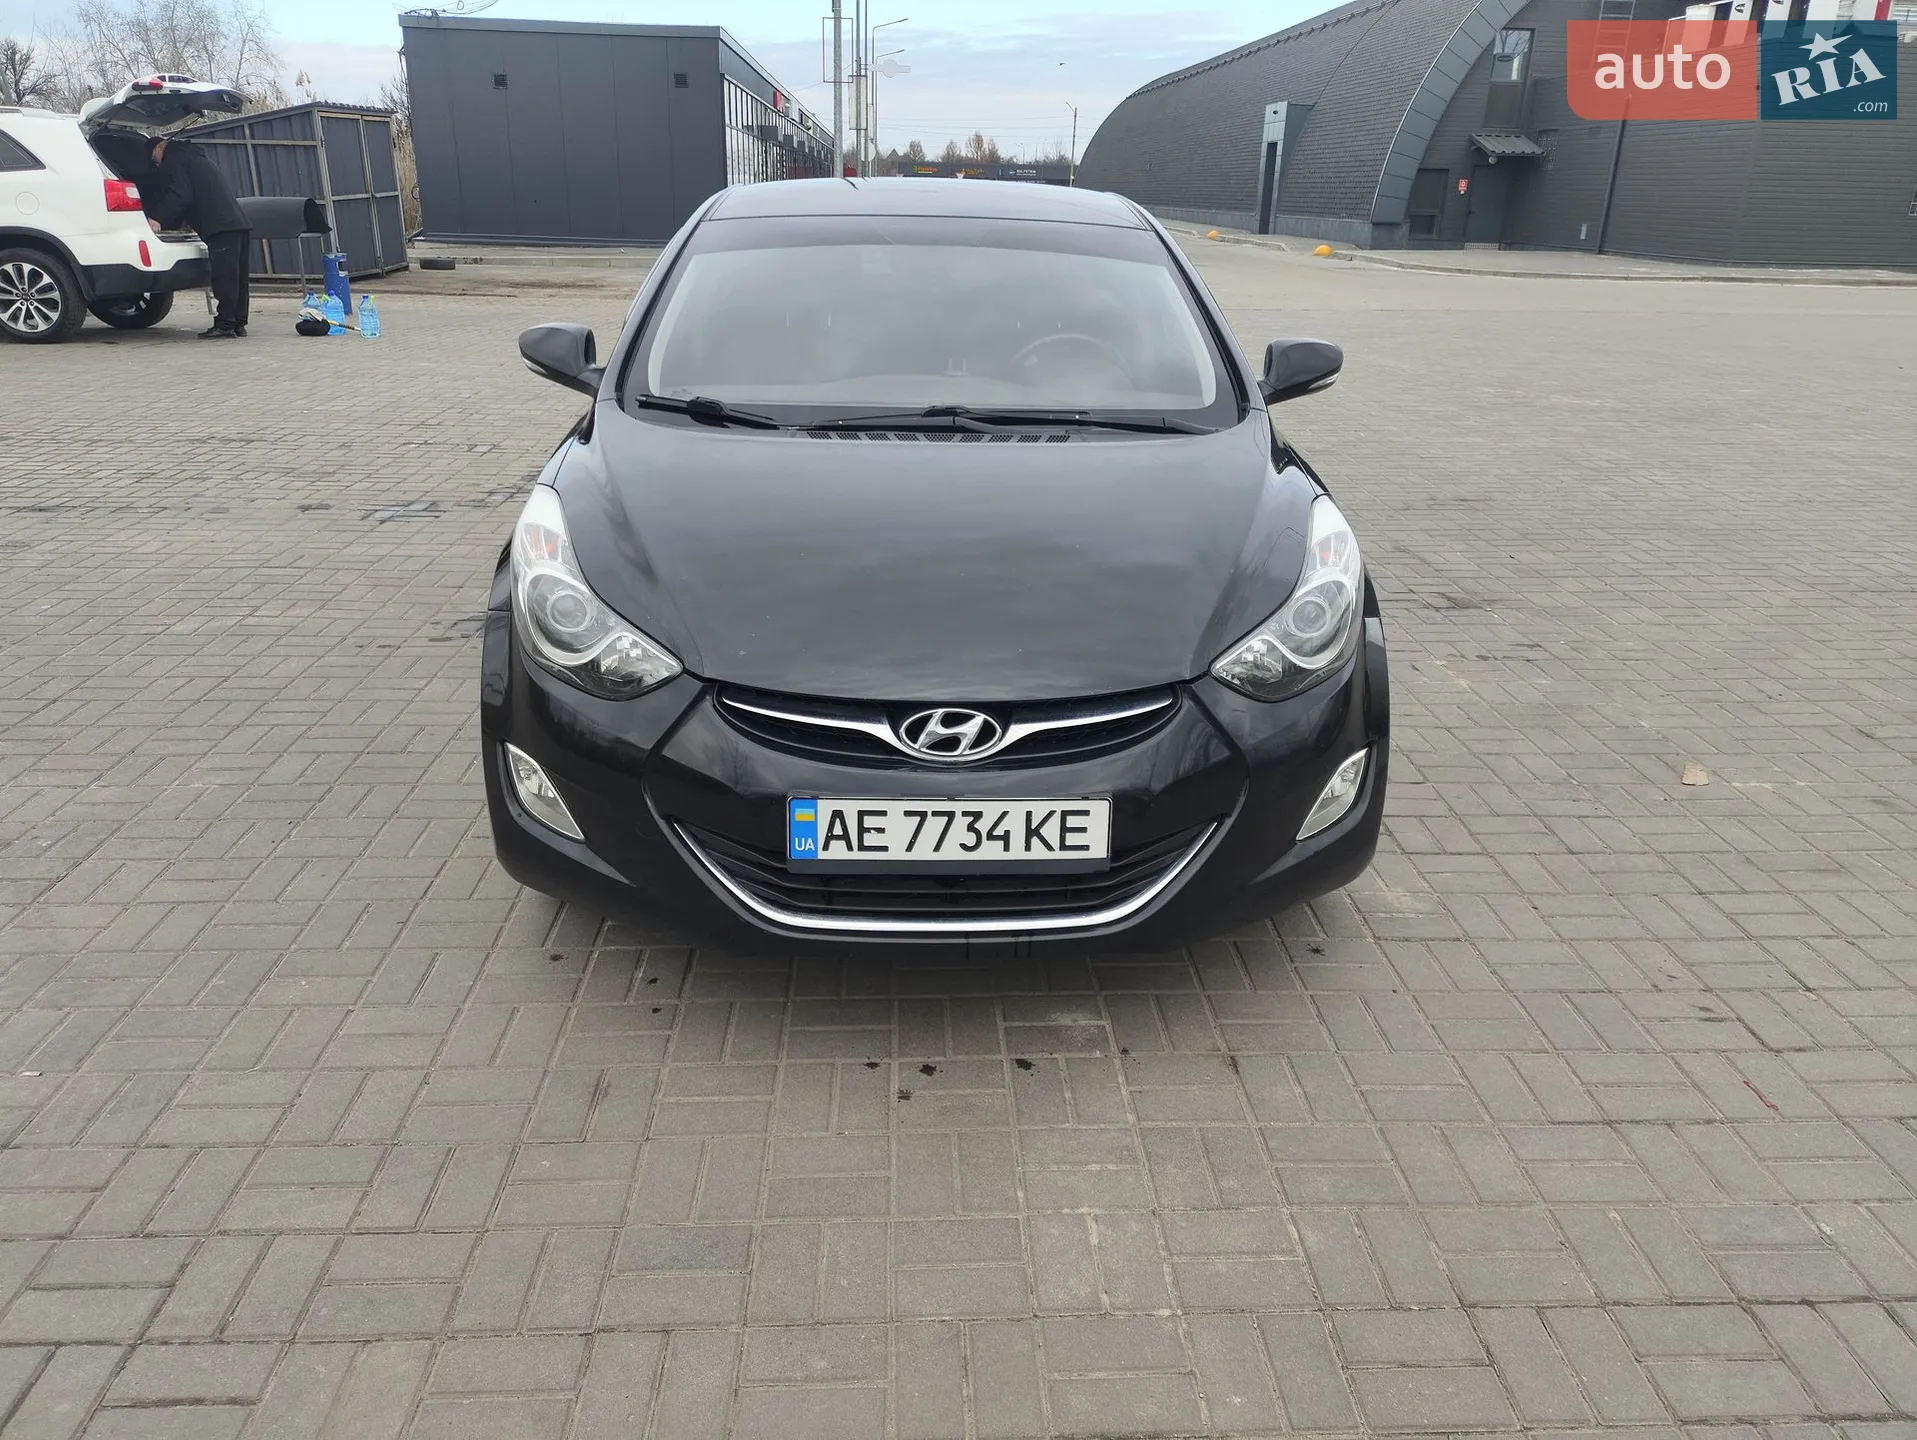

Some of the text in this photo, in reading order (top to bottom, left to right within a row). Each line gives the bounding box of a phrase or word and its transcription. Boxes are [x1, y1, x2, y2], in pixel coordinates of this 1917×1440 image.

[795, 837, 815, 851] UA
[822, 809, 1091, 852] AE 7734 KE
